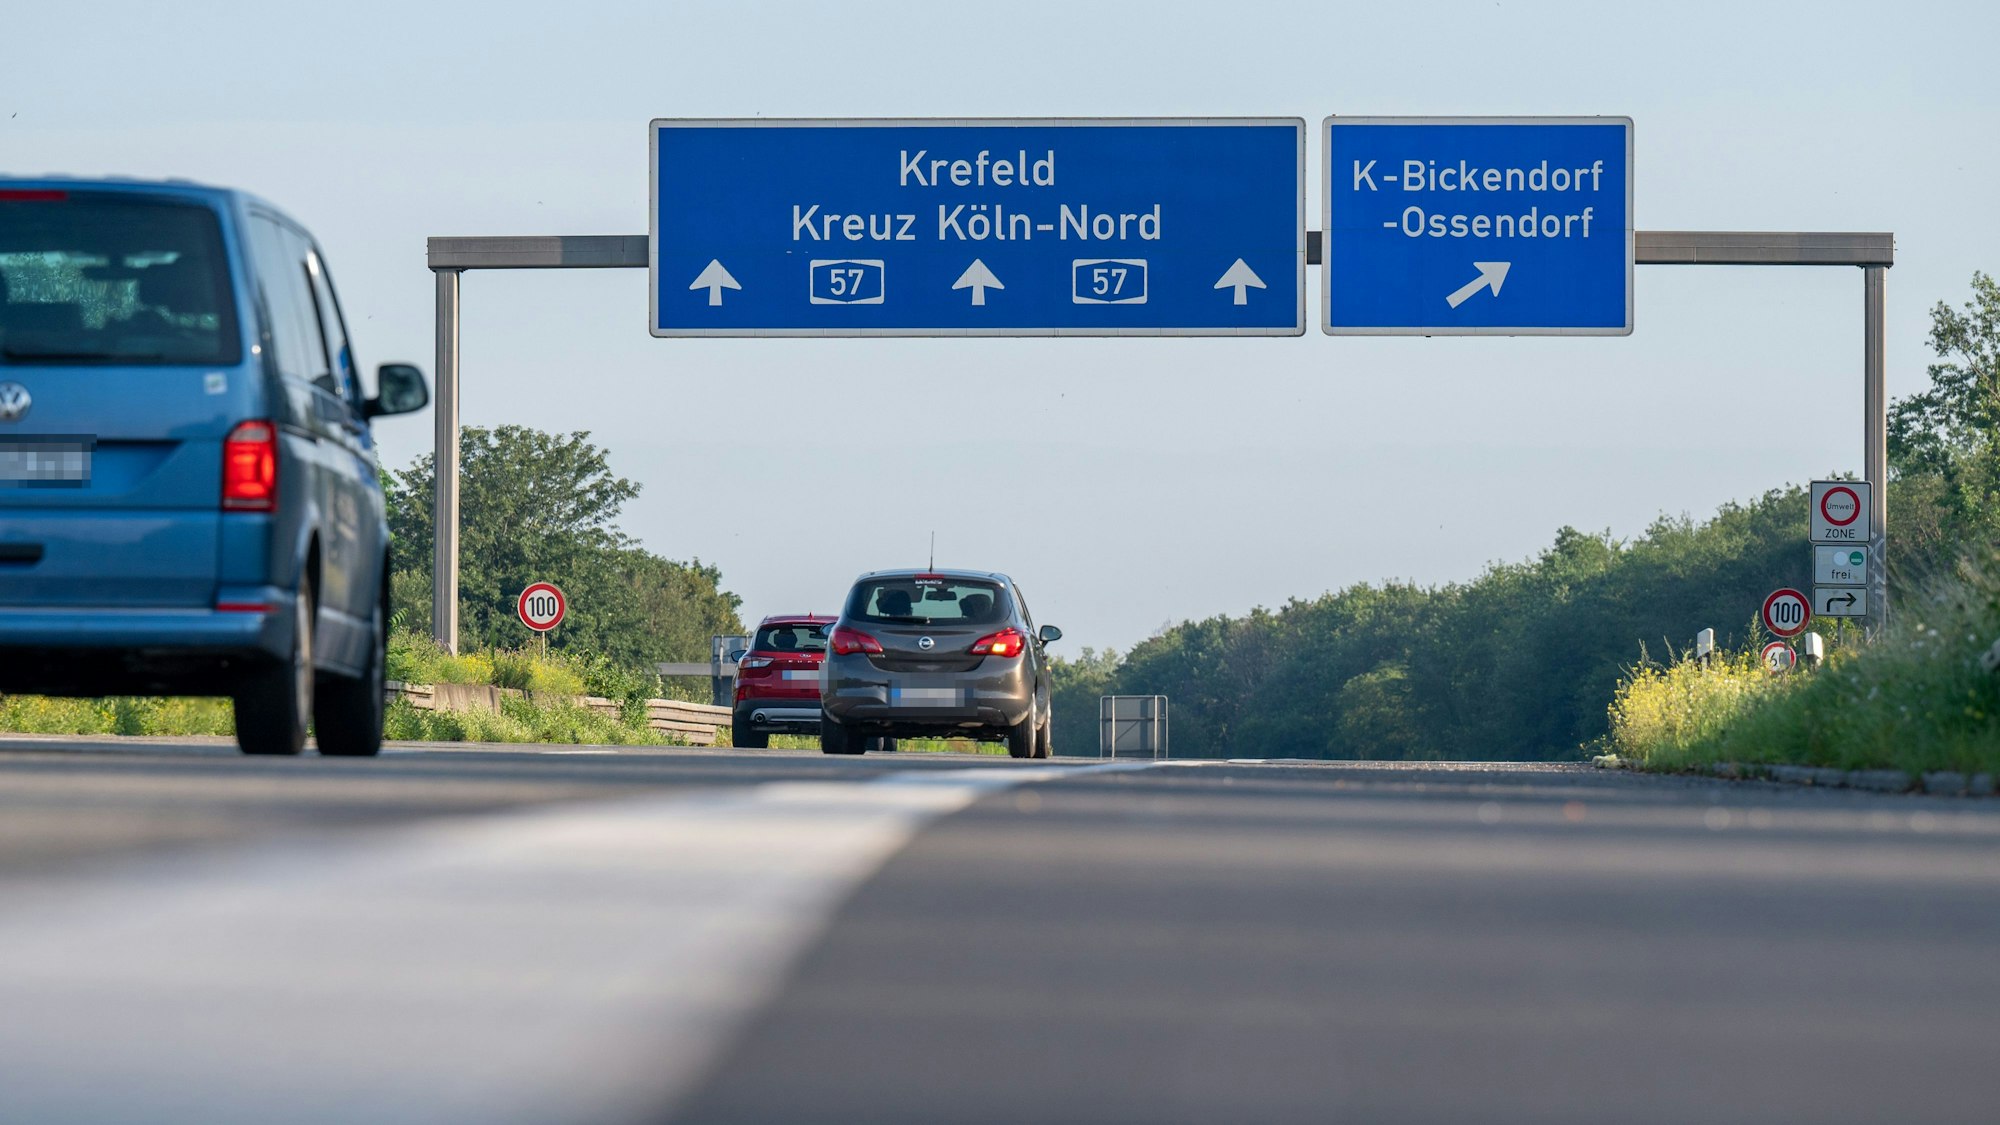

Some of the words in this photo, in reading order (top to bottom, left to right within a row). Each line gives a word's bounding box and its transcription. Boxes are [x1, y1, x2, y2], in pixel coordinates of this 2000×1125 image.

[900, 150, 1055, 187] Krefeld
[1353, 159, 1603, 191] K-Bickendorf
[793, 204, 916, 241] Kreuz
[938, 203, 1161, 241] Köln-Nord
[1383, 206, 1594, 238] -Ossendorf
[830, 269, 864, 296] 57
[1093, 268, 1127, 295] 57
[1826, 502, 1855, 510] Umwelt
[1825, 528, 1856, 539] ZONE
[1831, 568, 1851, 580] frei
[528, 596, 556, 617] 100
[1773, 601, 1802, 624] 100
